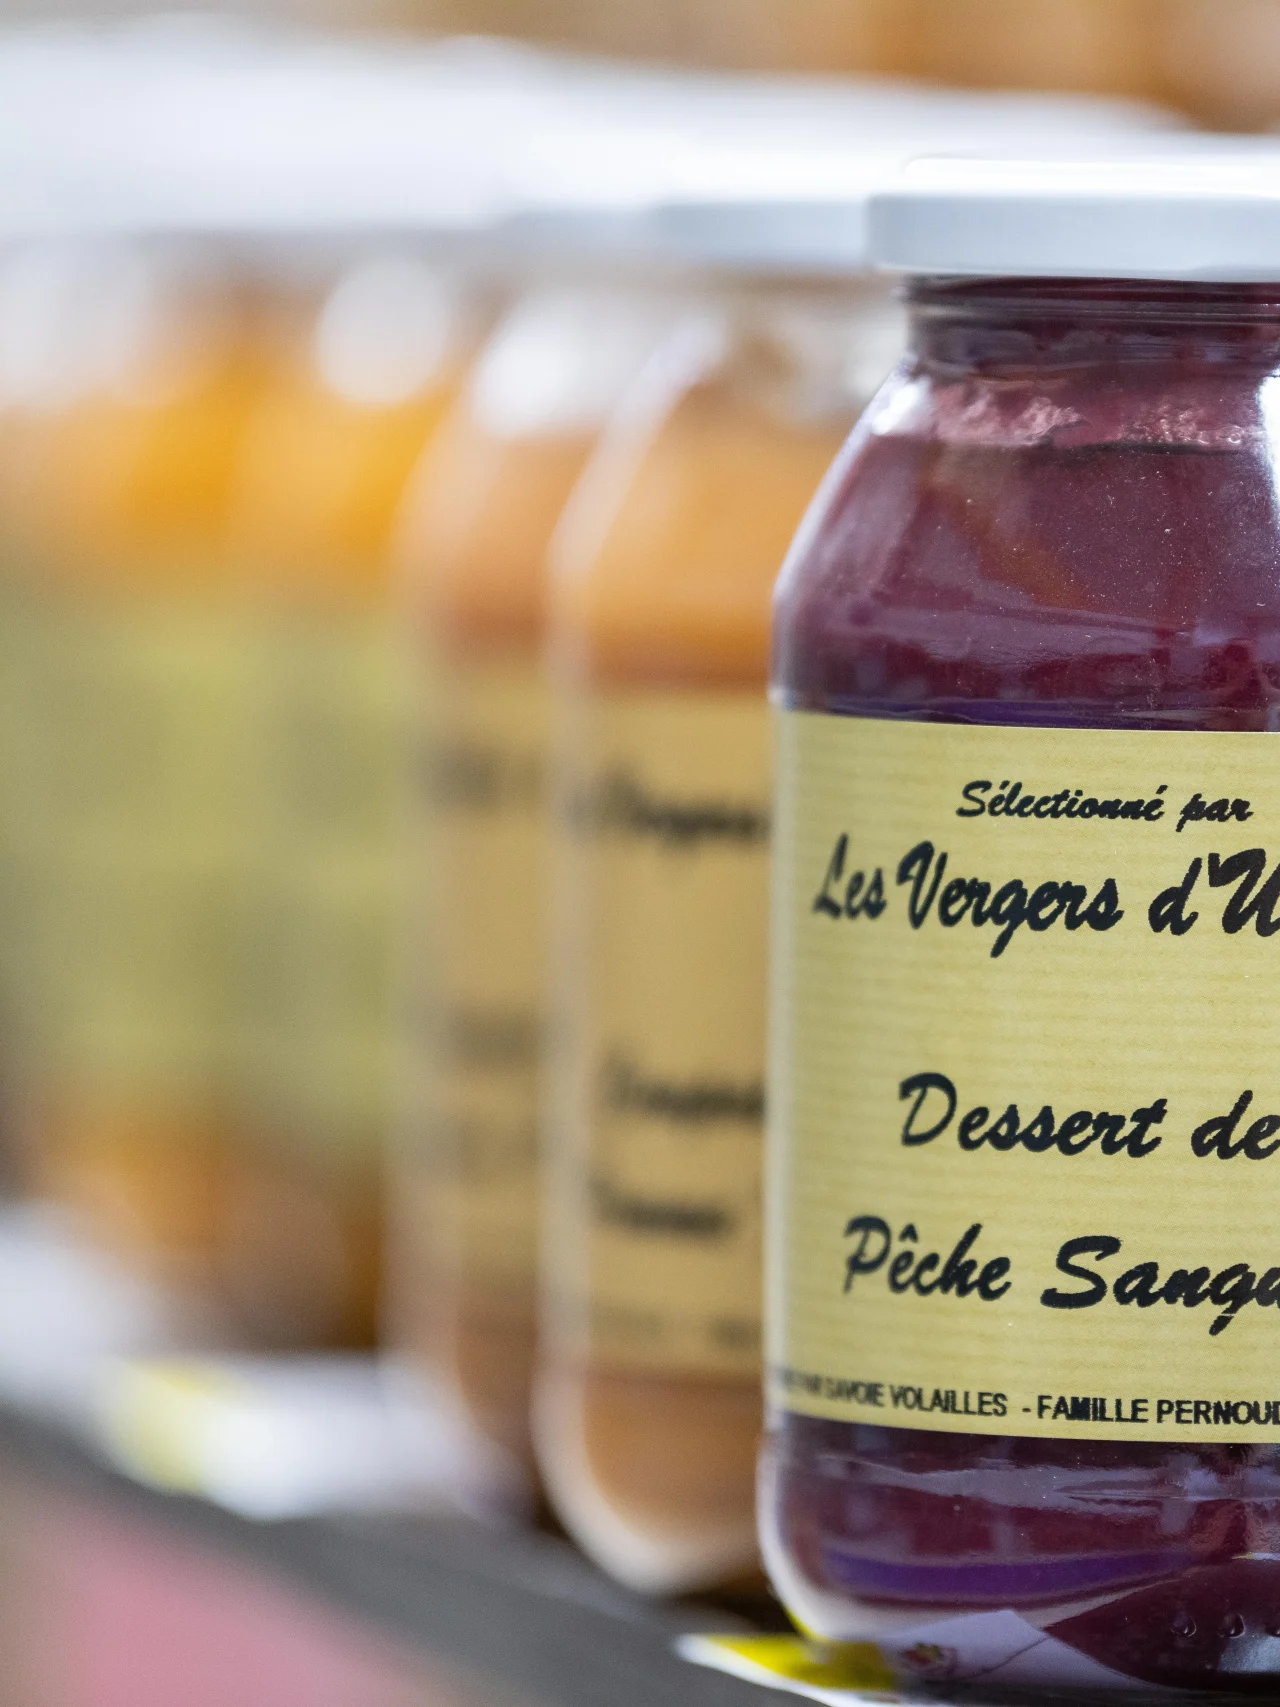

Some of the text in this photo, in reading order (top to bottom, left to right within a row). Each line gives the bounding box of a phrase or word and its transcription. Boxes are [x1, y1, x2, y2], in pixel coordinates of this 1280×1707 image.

[955, 779, 1255, 833] Sélectionné par
[811, 832, 889, 921] Les
[895, 840, 1125, 959] Vergers
[898, 1071, 1169, 1160] Dessert
[843, 1213, 1013, 1303] Pêche
[889, 1383, 1009, 1418] VOLAILLES
[1036, 1394, 1150, 1425] FAMILLE
